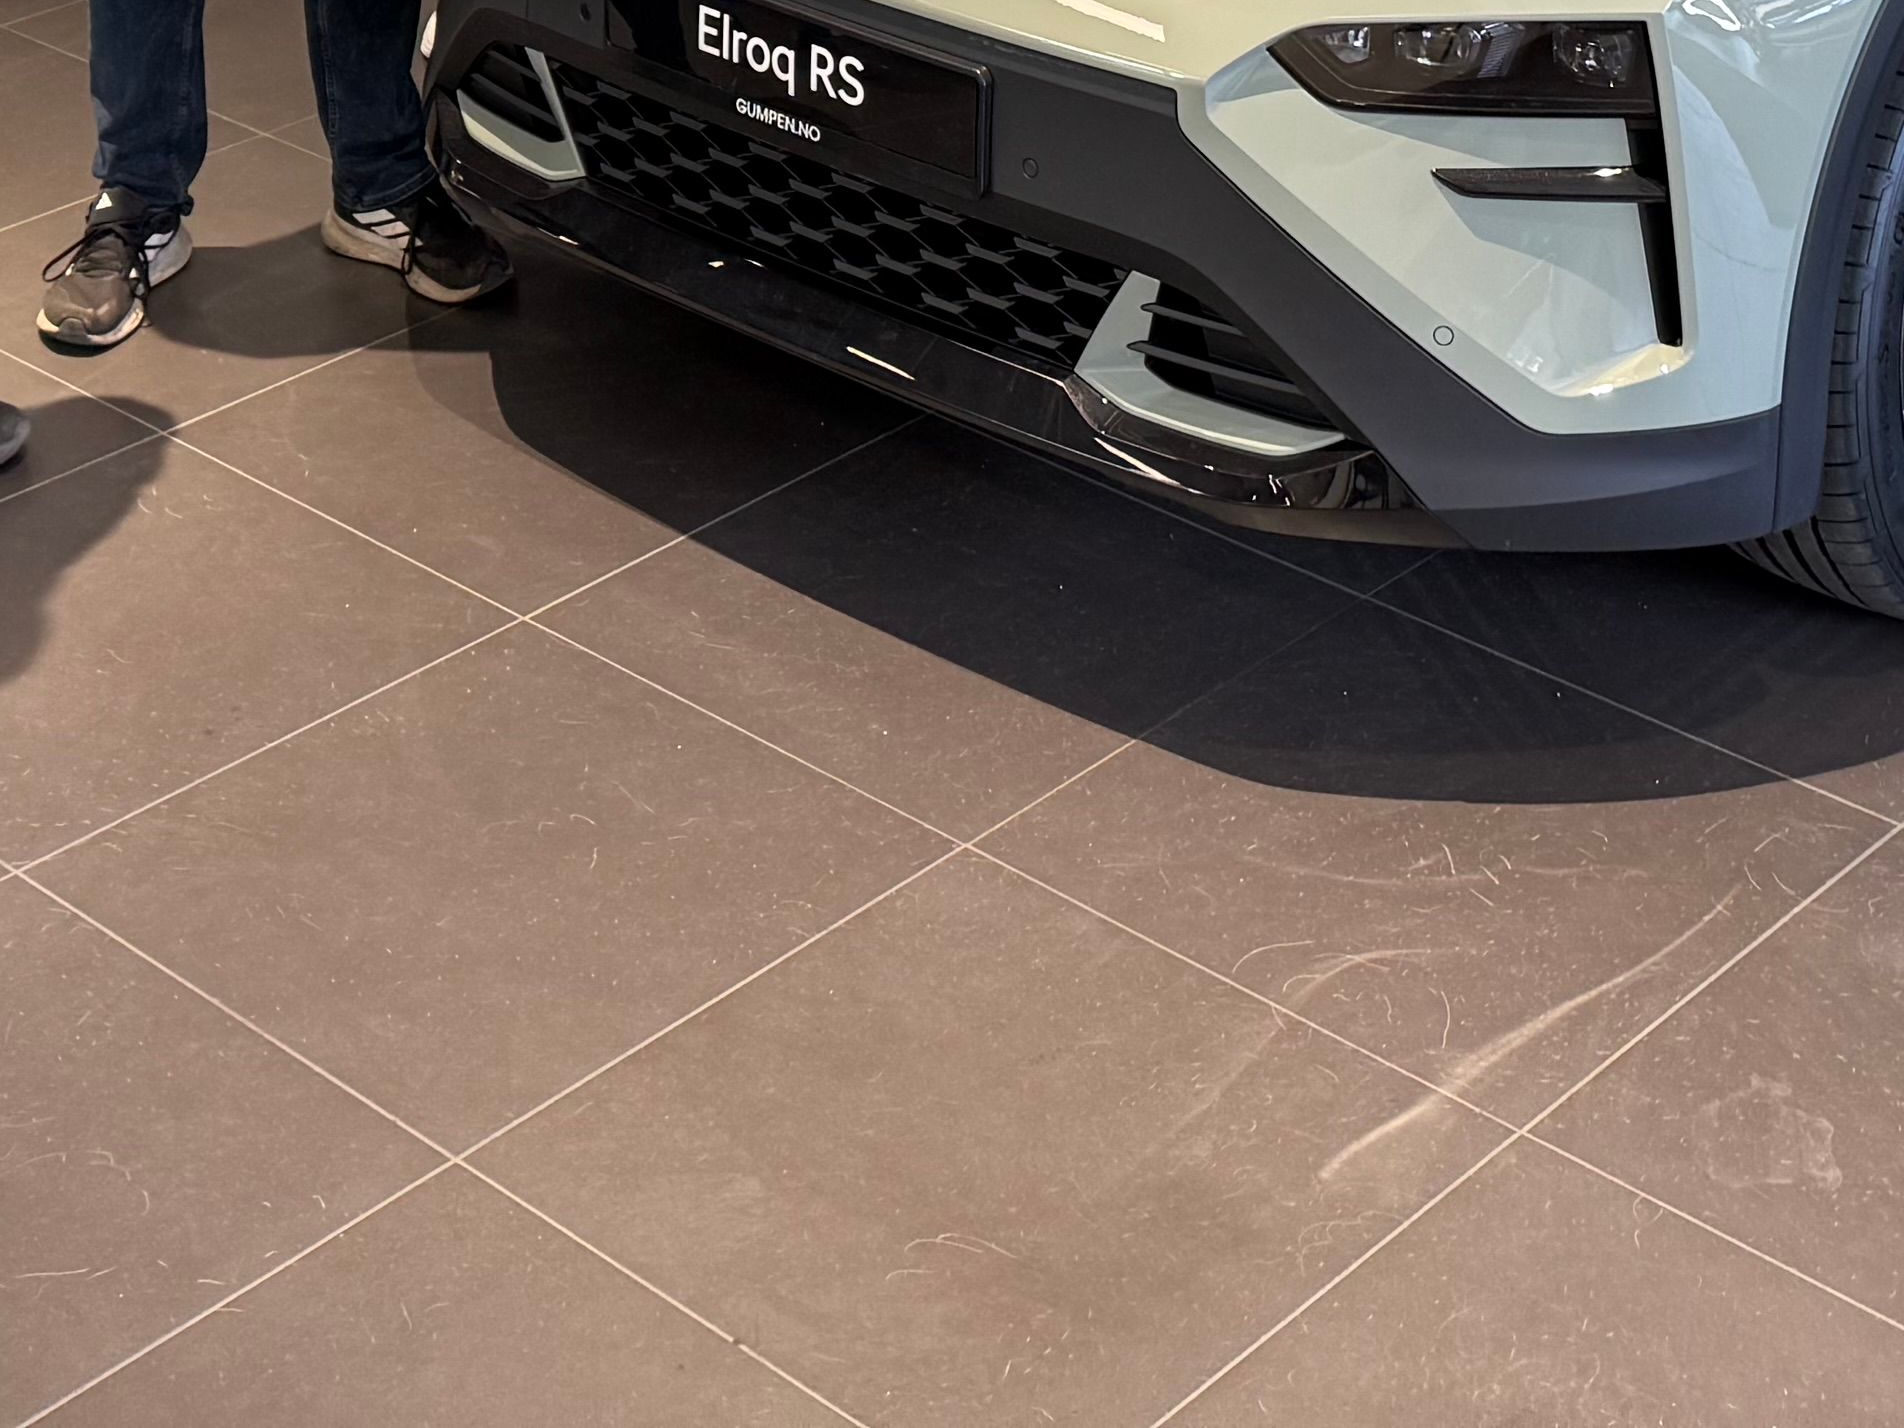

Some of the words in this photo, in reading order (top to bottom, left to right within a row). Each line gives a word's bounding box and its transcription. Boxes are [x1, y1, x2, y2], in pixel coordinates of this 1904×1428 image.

[698, 4, 796, 97] Elroq
[810, 43, 865, 107] RS
[735, 97, 821, 142] GUMPEN.NO
